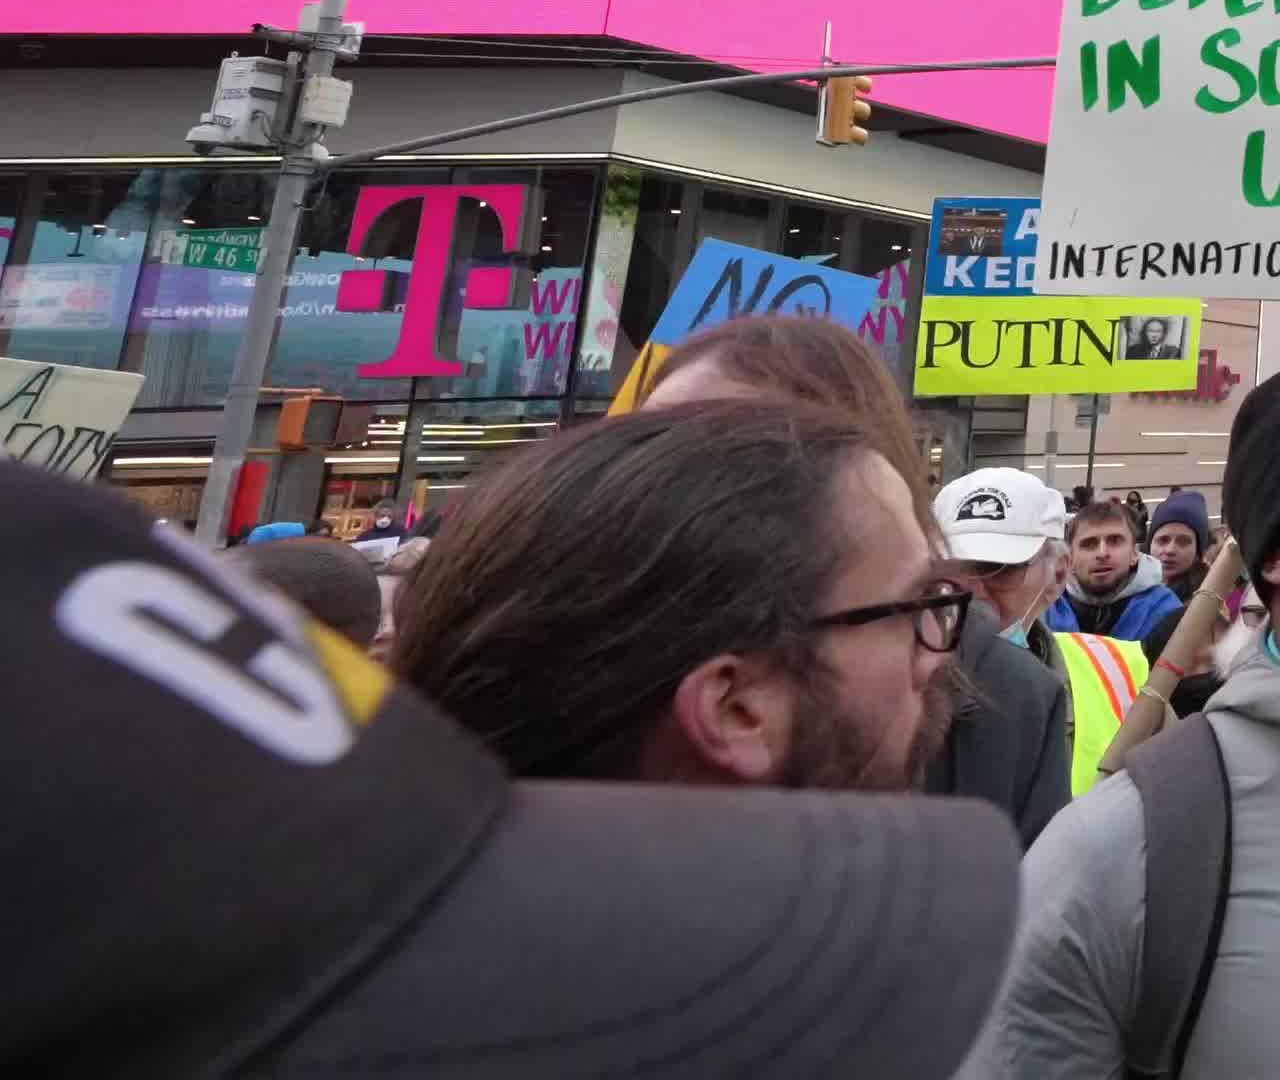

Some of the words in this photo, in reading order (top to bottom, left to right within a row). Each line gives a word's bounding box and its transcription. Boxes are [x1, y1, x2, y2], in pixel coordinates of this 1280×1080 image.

[1079, 34, 1161, 114] IN
[189, 243, 208, 264] W
[214, 247, 238, 267] 46
[919, 317, 1120, 370] PUTIN
